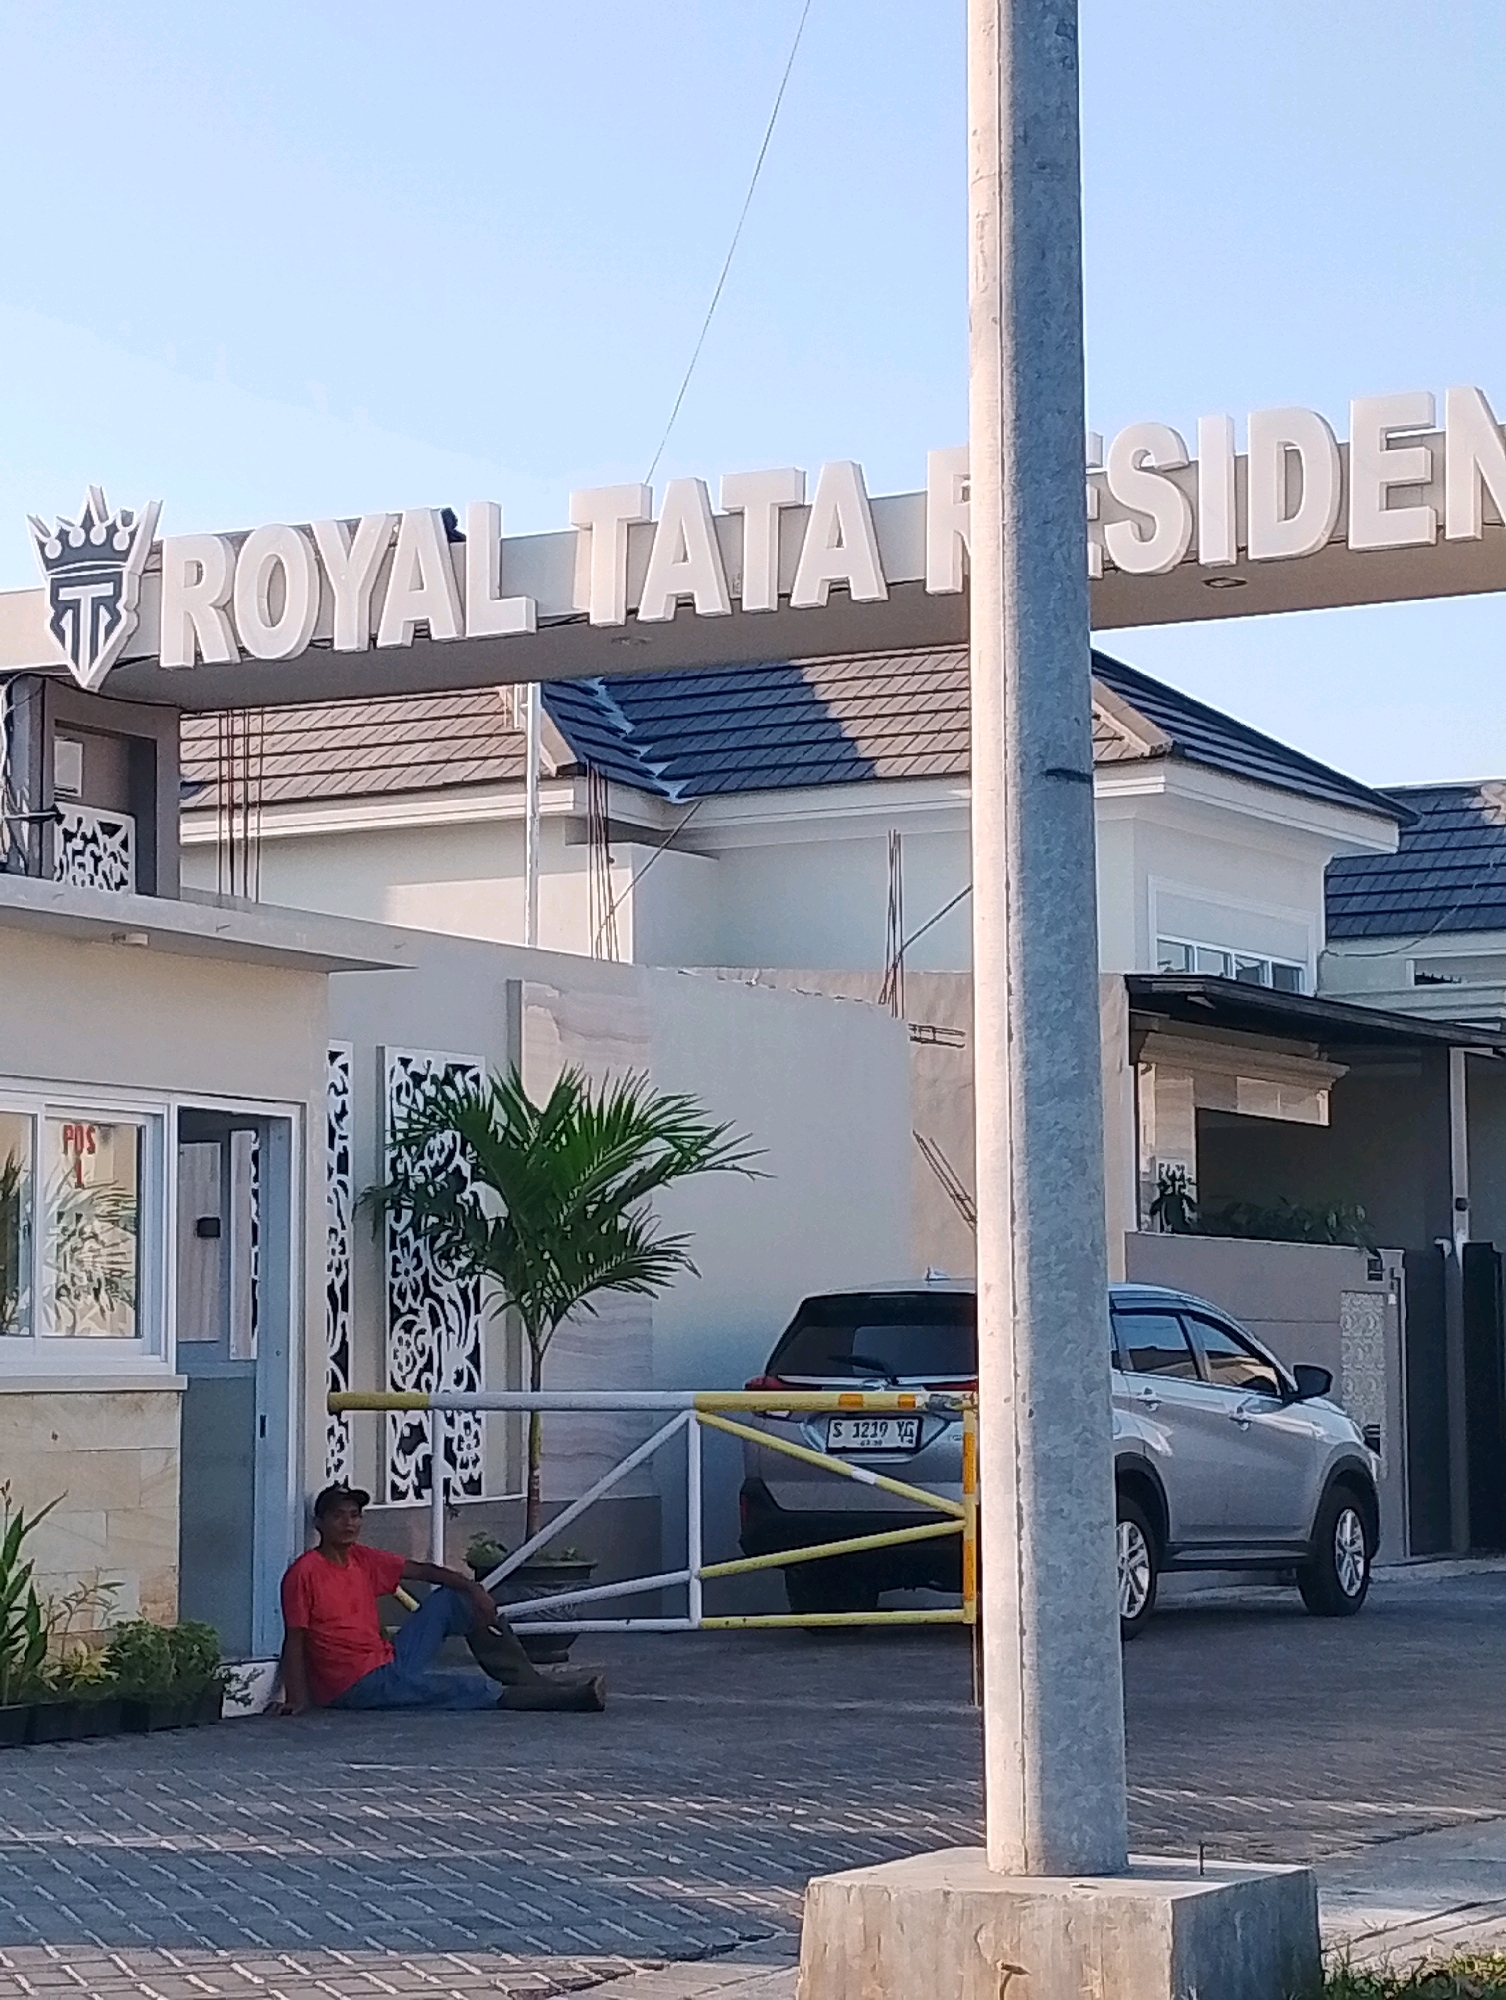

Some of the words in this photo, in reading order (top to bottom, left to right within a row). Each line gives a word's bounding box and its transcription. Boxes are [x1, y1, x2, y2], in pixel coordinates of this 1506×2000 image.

[159, 500, 536, 670] ROYAL
[570, 460, 889, 627] TATA
[926, 385, 1506, 595] RSIDEN
[63, 1124, 96, 1156] POS
[832, 1421, 843, 1438] S
